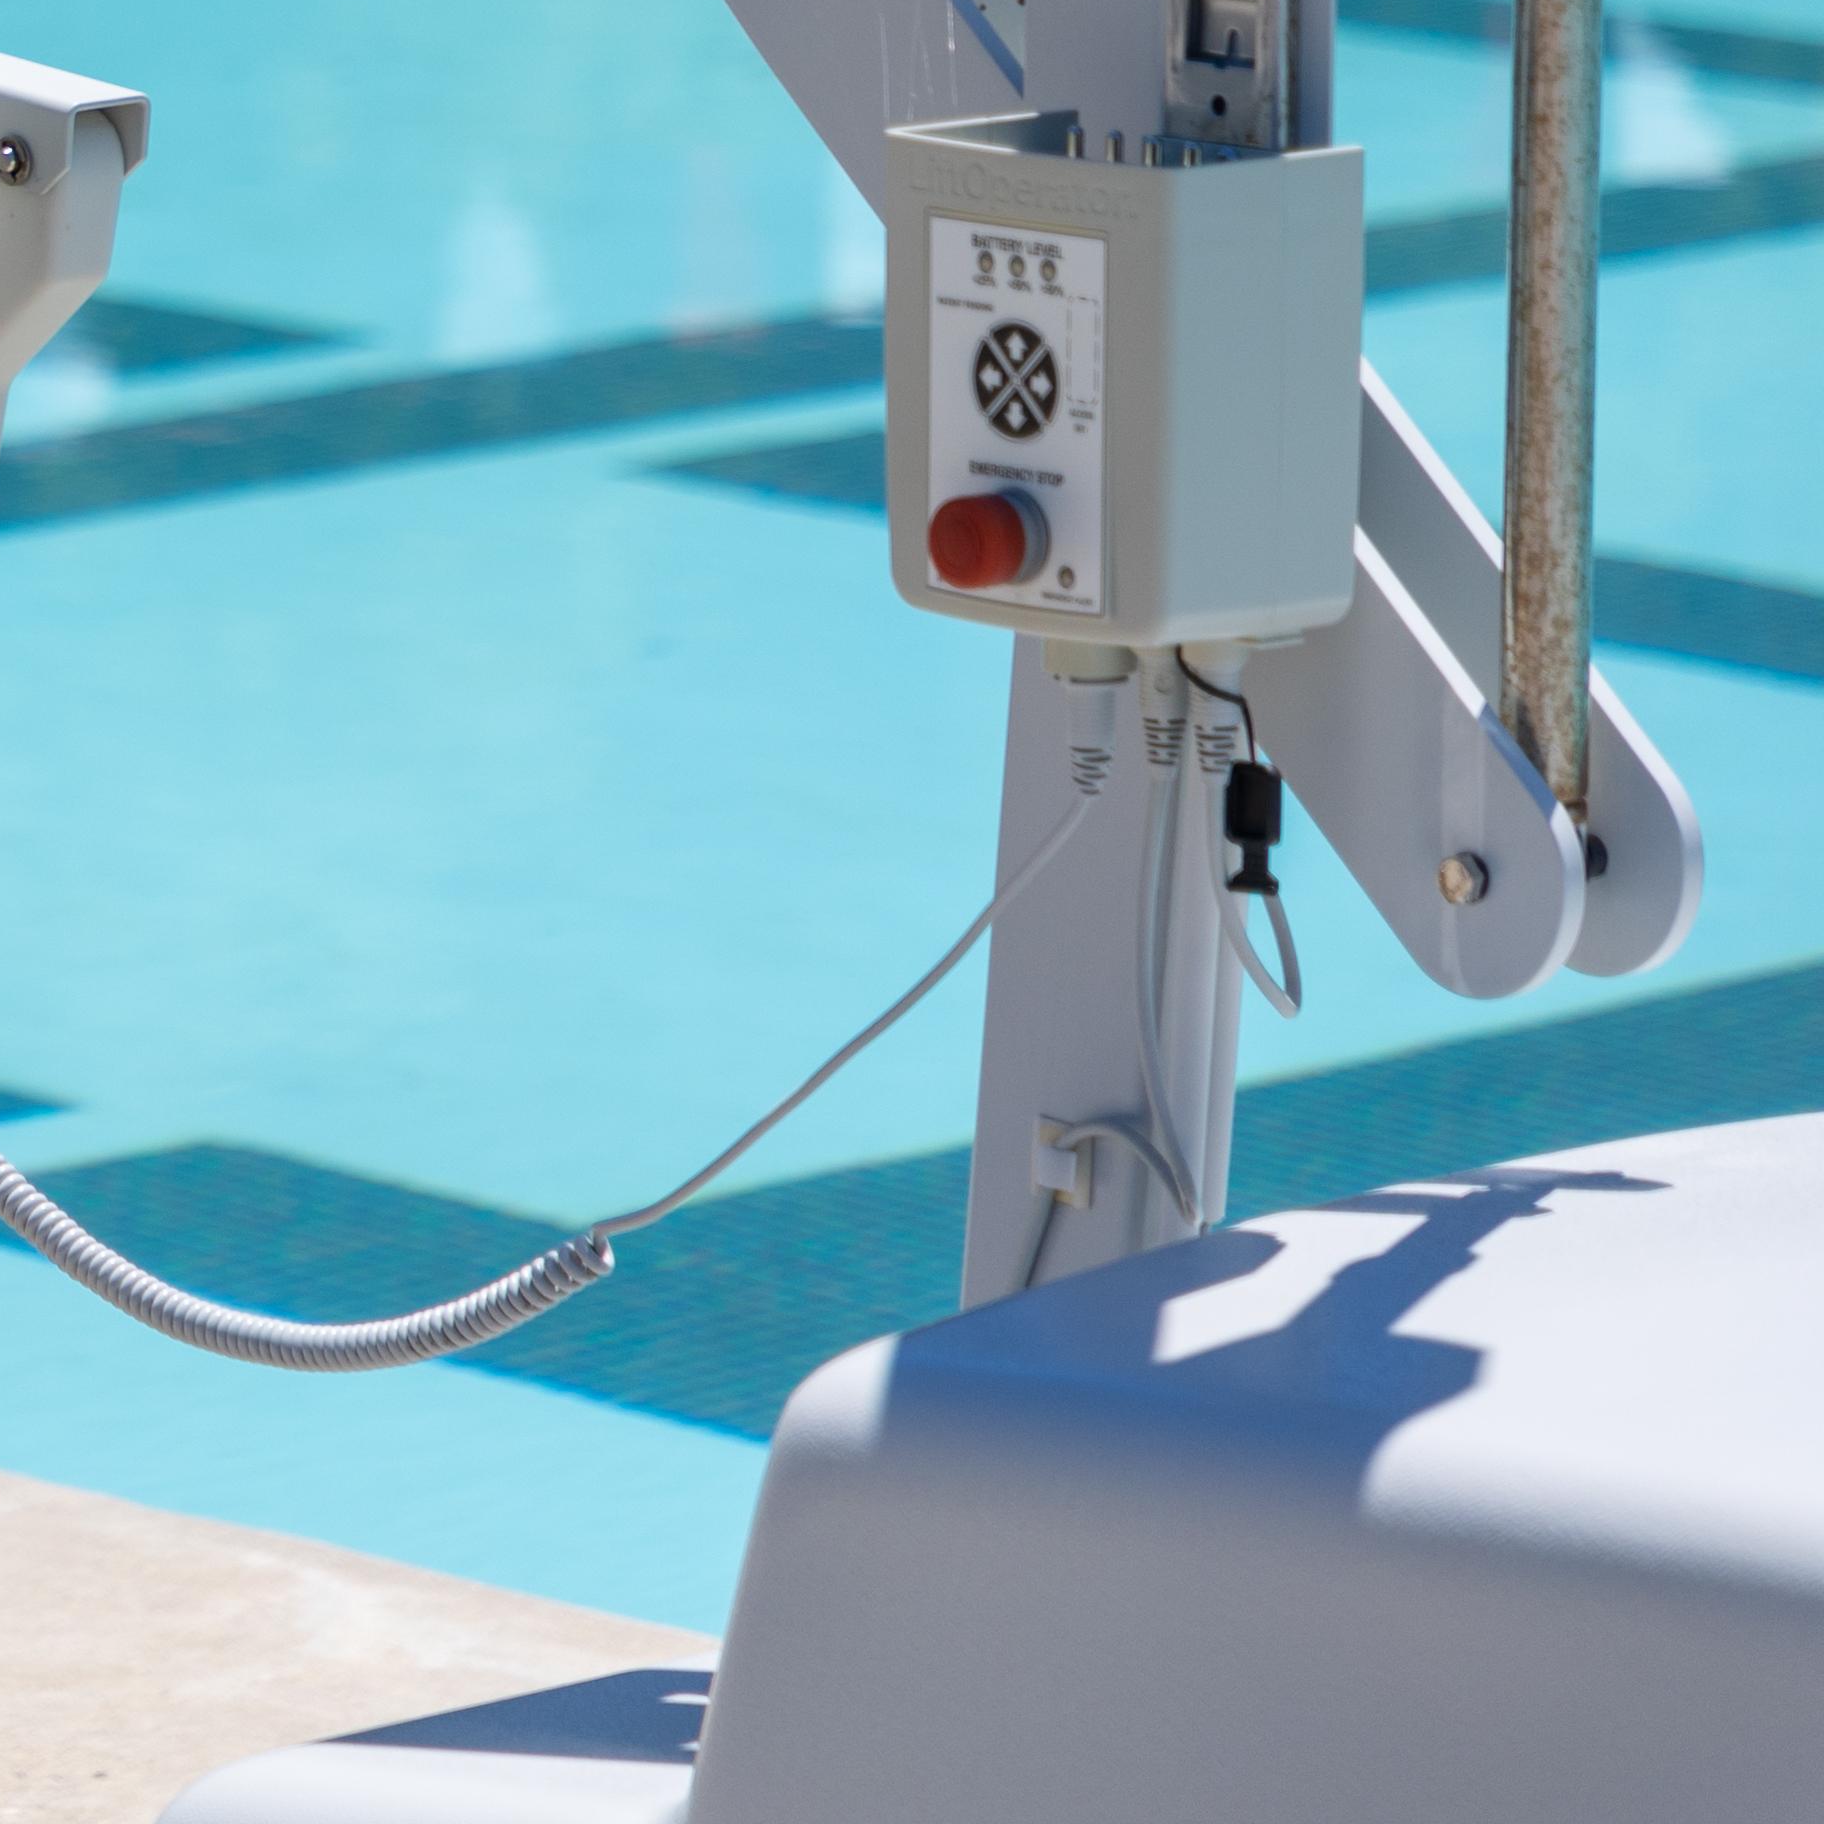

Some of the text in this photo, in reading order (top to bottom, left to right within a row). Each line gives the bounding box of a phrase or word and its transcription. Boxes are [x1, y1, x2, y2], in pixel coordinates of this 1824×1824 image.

[971, 233, 1064, 259] BATTERY LEVEL
[969, 460, 1063, 487] EMERGENCY STOP
